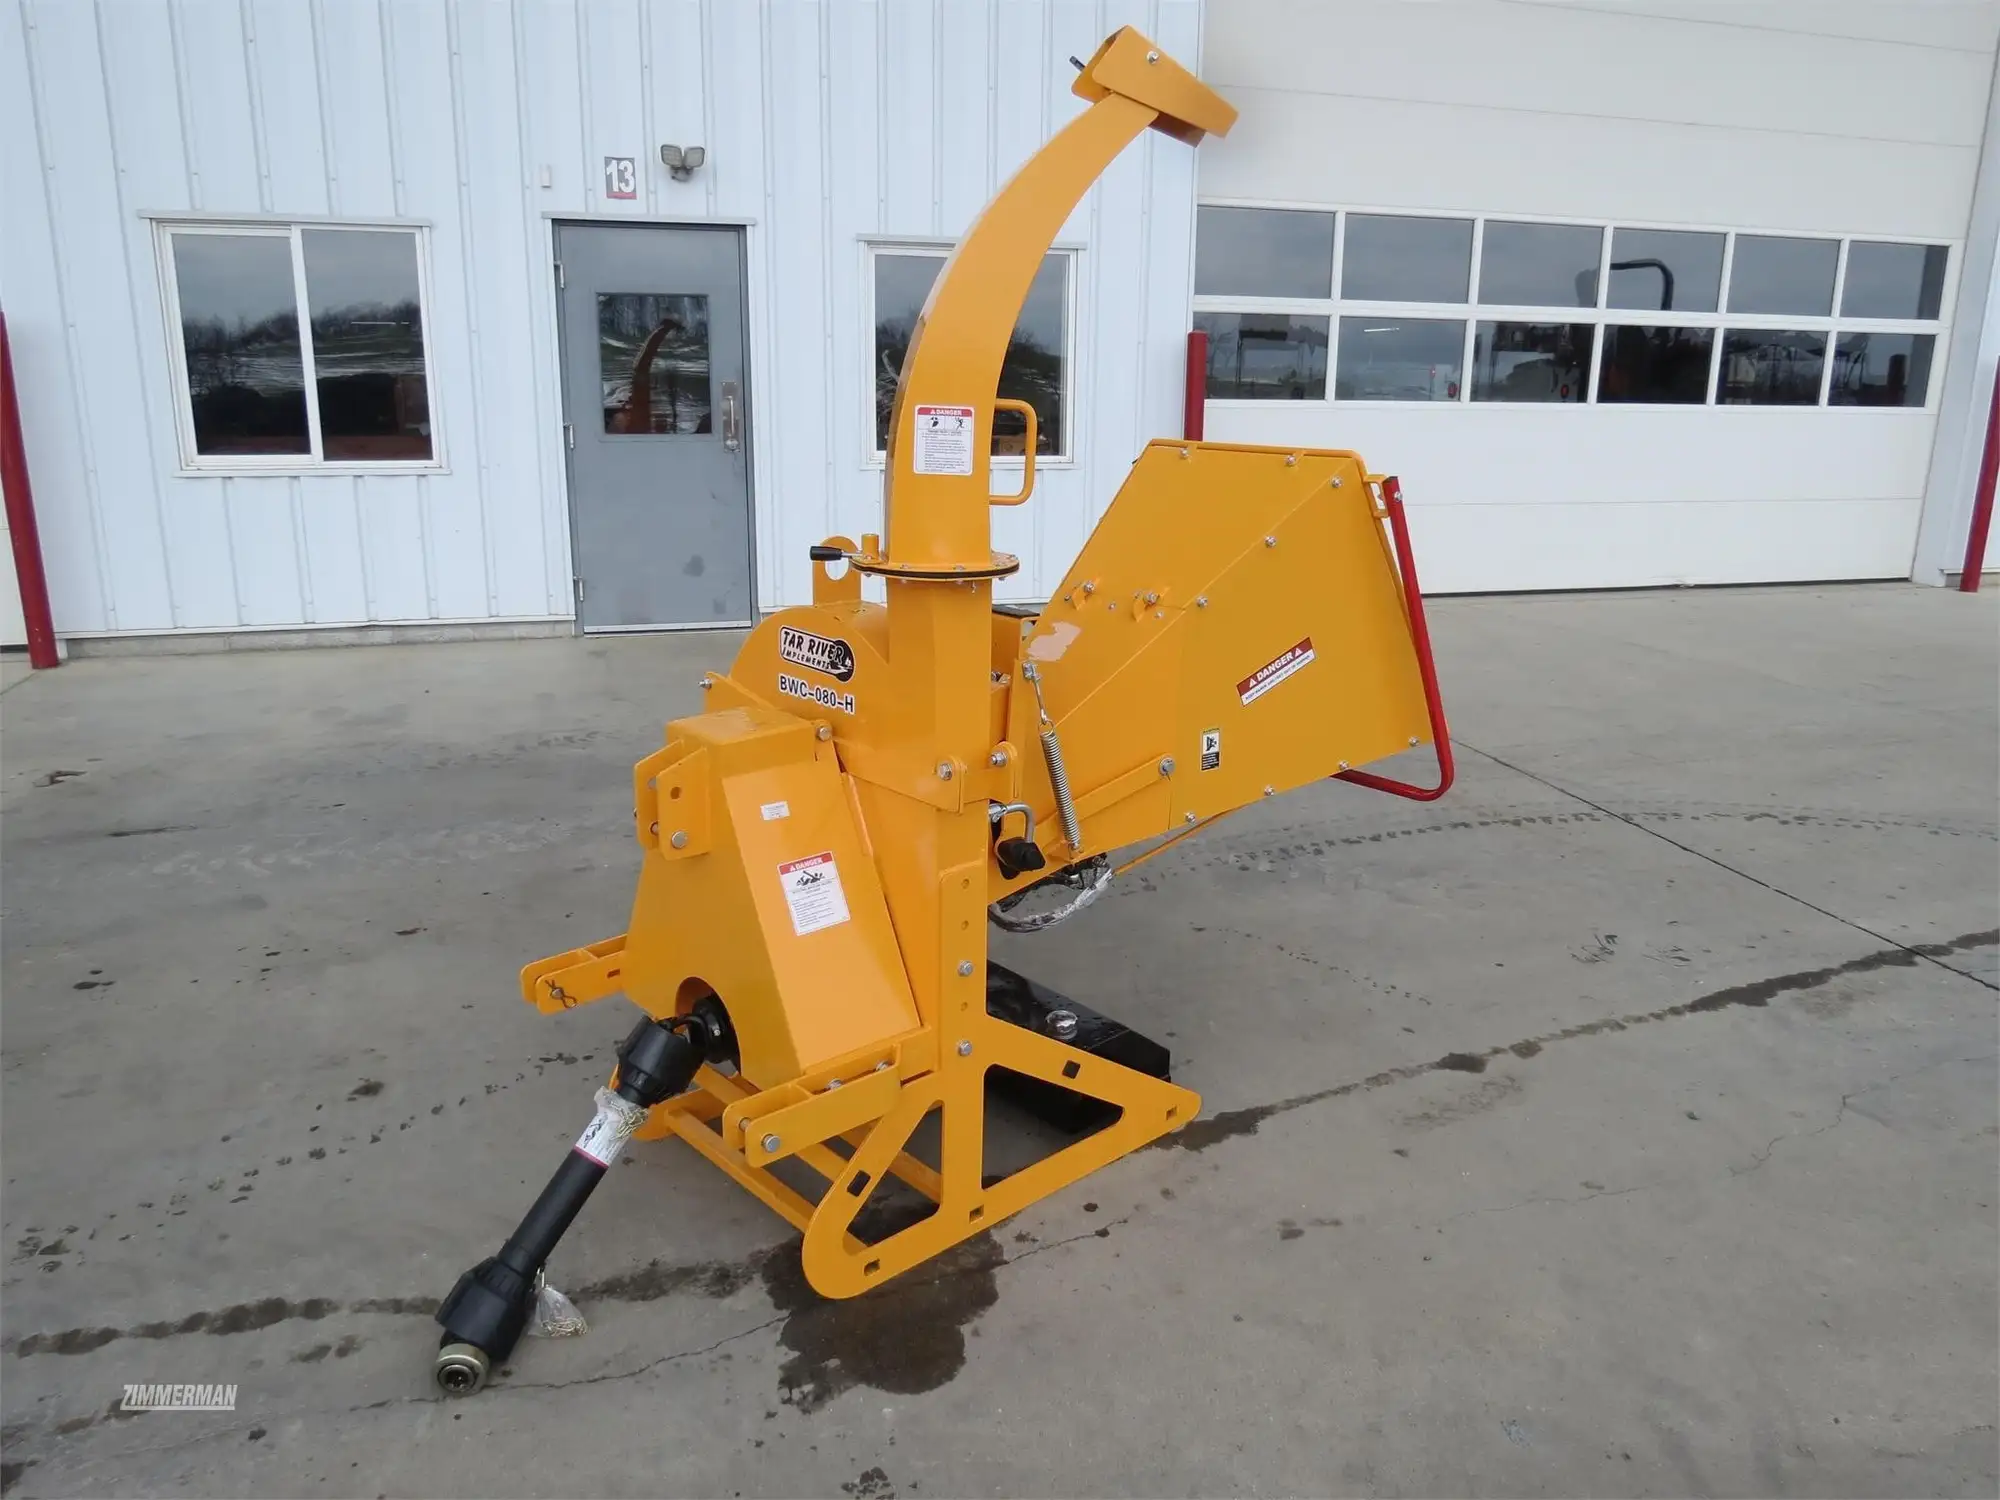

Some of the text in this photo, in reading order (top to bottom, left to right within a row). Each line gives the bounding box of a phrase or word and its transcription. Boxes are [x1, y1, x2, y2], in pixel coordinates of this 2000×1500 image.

[606, 159, 635, 193] 13
[936, 408, 962, 416] DANGER
[782, 647, 830, 669] IMPLEMENTS
[783, 631, 844, 664] TAR RIVER
[1256, 651, 1294, 682] DANGER
[780, 675, 854, 712] BWC-080-H
